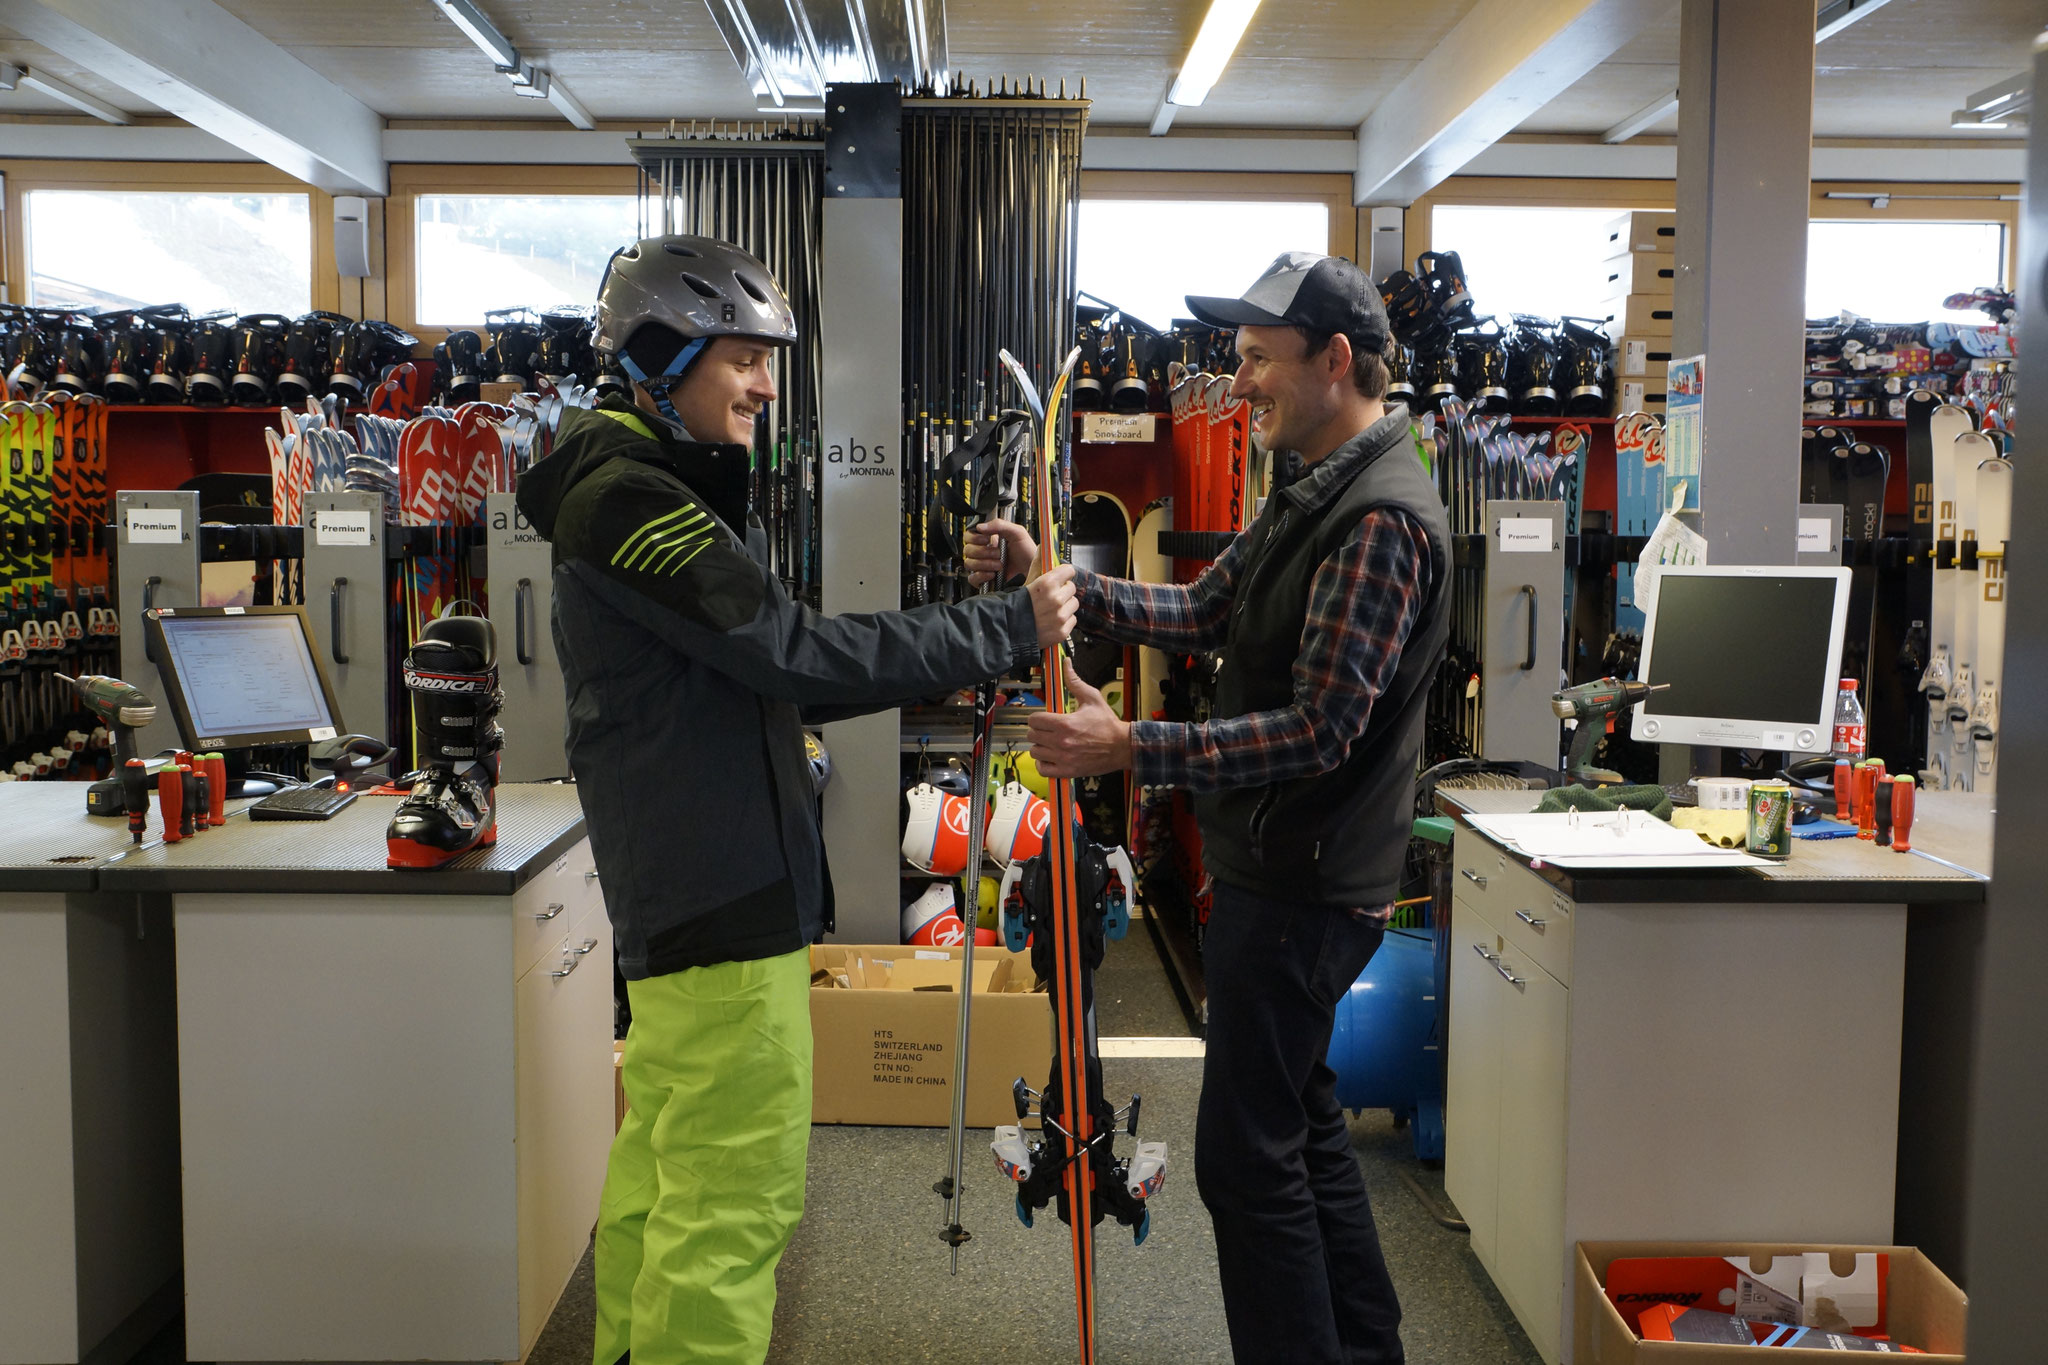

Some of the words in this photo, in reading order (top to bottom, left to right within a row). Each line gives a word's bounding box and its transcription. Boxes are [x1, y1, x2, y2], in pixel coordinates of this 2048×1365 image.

[1094, 429, 1143, 439] Snowboard
[828, 437, 885, 463] abs
[850, 467, 895, 476] MONTANA
[1231, 418, 1242, 532] TÖCKLI
[492, 504, 530, 530] ab
[404, 671, 476, 692] NORDICA
[874, 1030, 893, 1038] HTS
[874, 1041, 943, 1052] SWITZERLAND
[873, 1052, 923, 1062] ZHEJIANG
[873, 1063, 893, 1072] CTN
[895, 1064, 913, 1073] NO:
[873, 1075, 902, 1084] MADE
[904, 1076, 913, 1084] IN
[915, 1077, 947, 1086] CHINA
